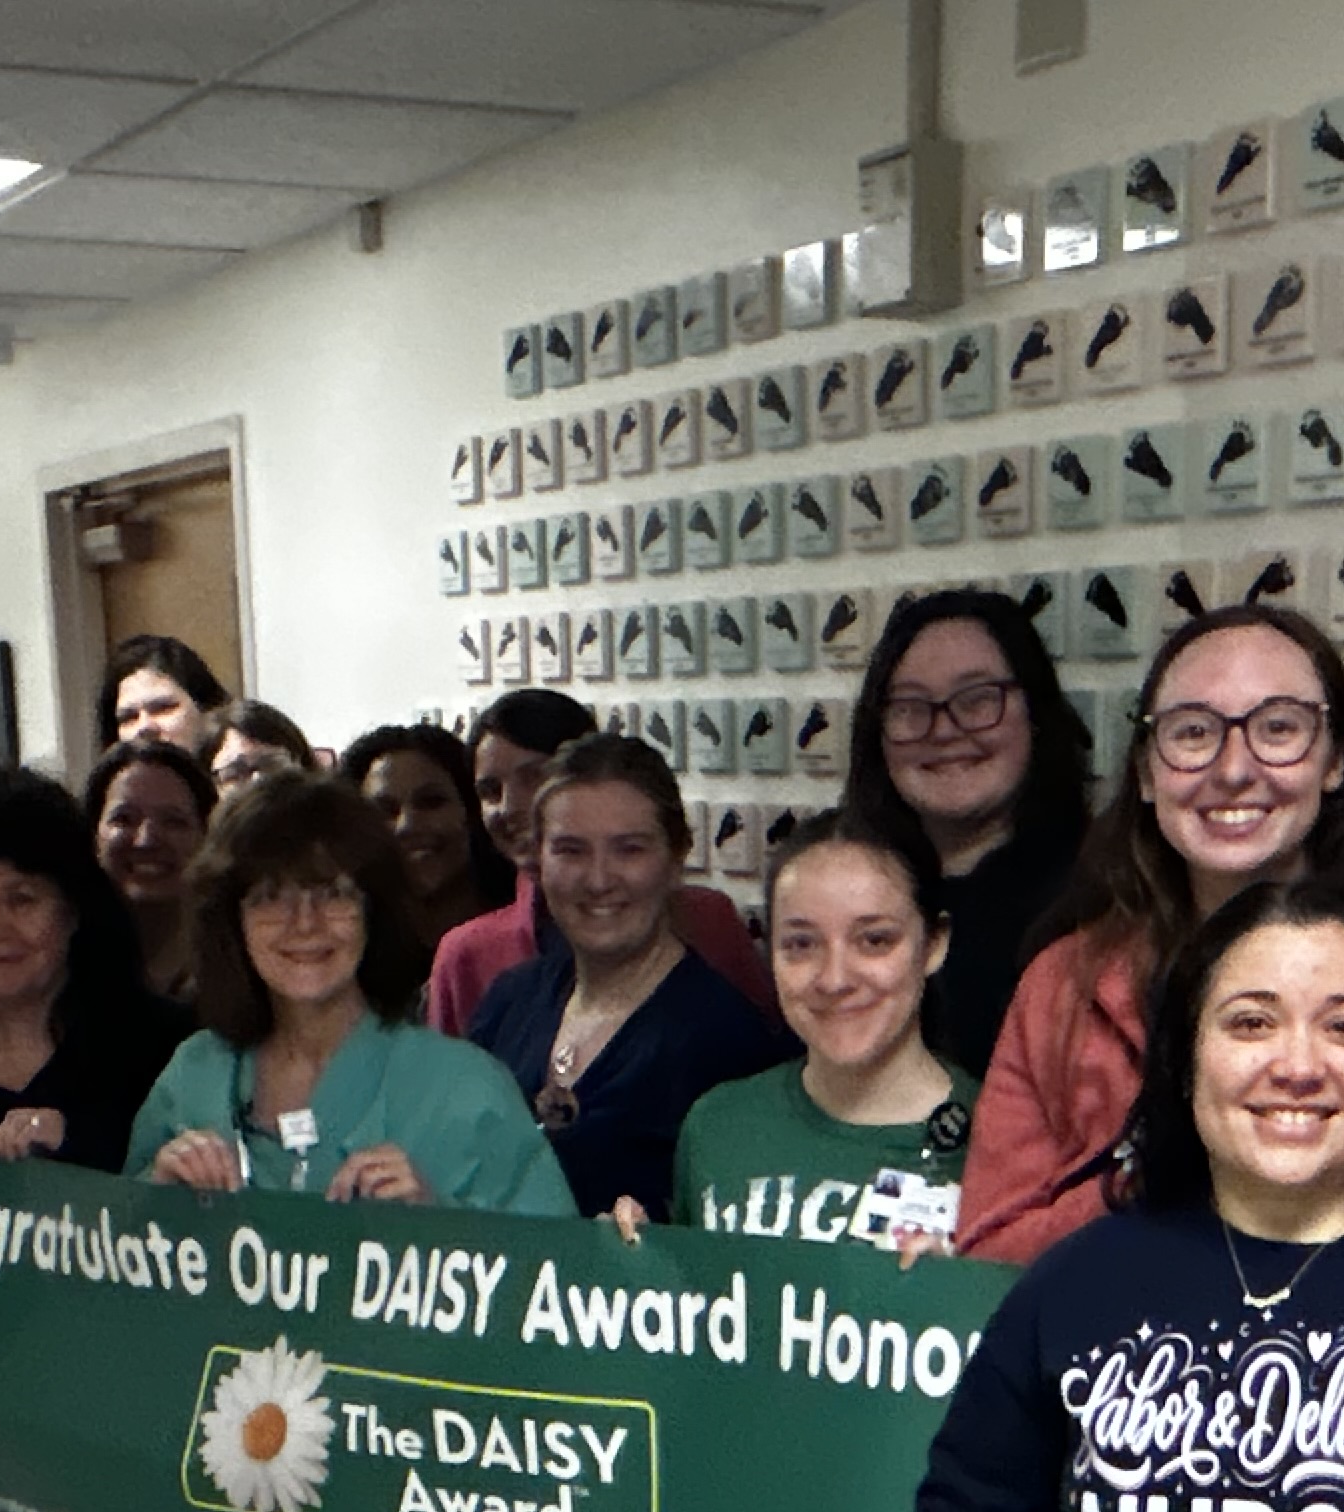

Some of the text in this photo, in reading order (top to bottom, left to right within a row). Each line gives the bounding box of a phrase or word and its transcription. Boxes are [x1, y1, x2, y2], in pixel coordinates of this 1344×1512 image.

[229, 1227, 330, 1313] Our
[352, 1241, 507, 1337] DAISY
[522, 1258, 748, 1364] Award
[341, 1402, 628, 1484] The DAISY
[1061, 1340, 1219, 1489] Labor
[1207, 1390, 1240, 1447] &
